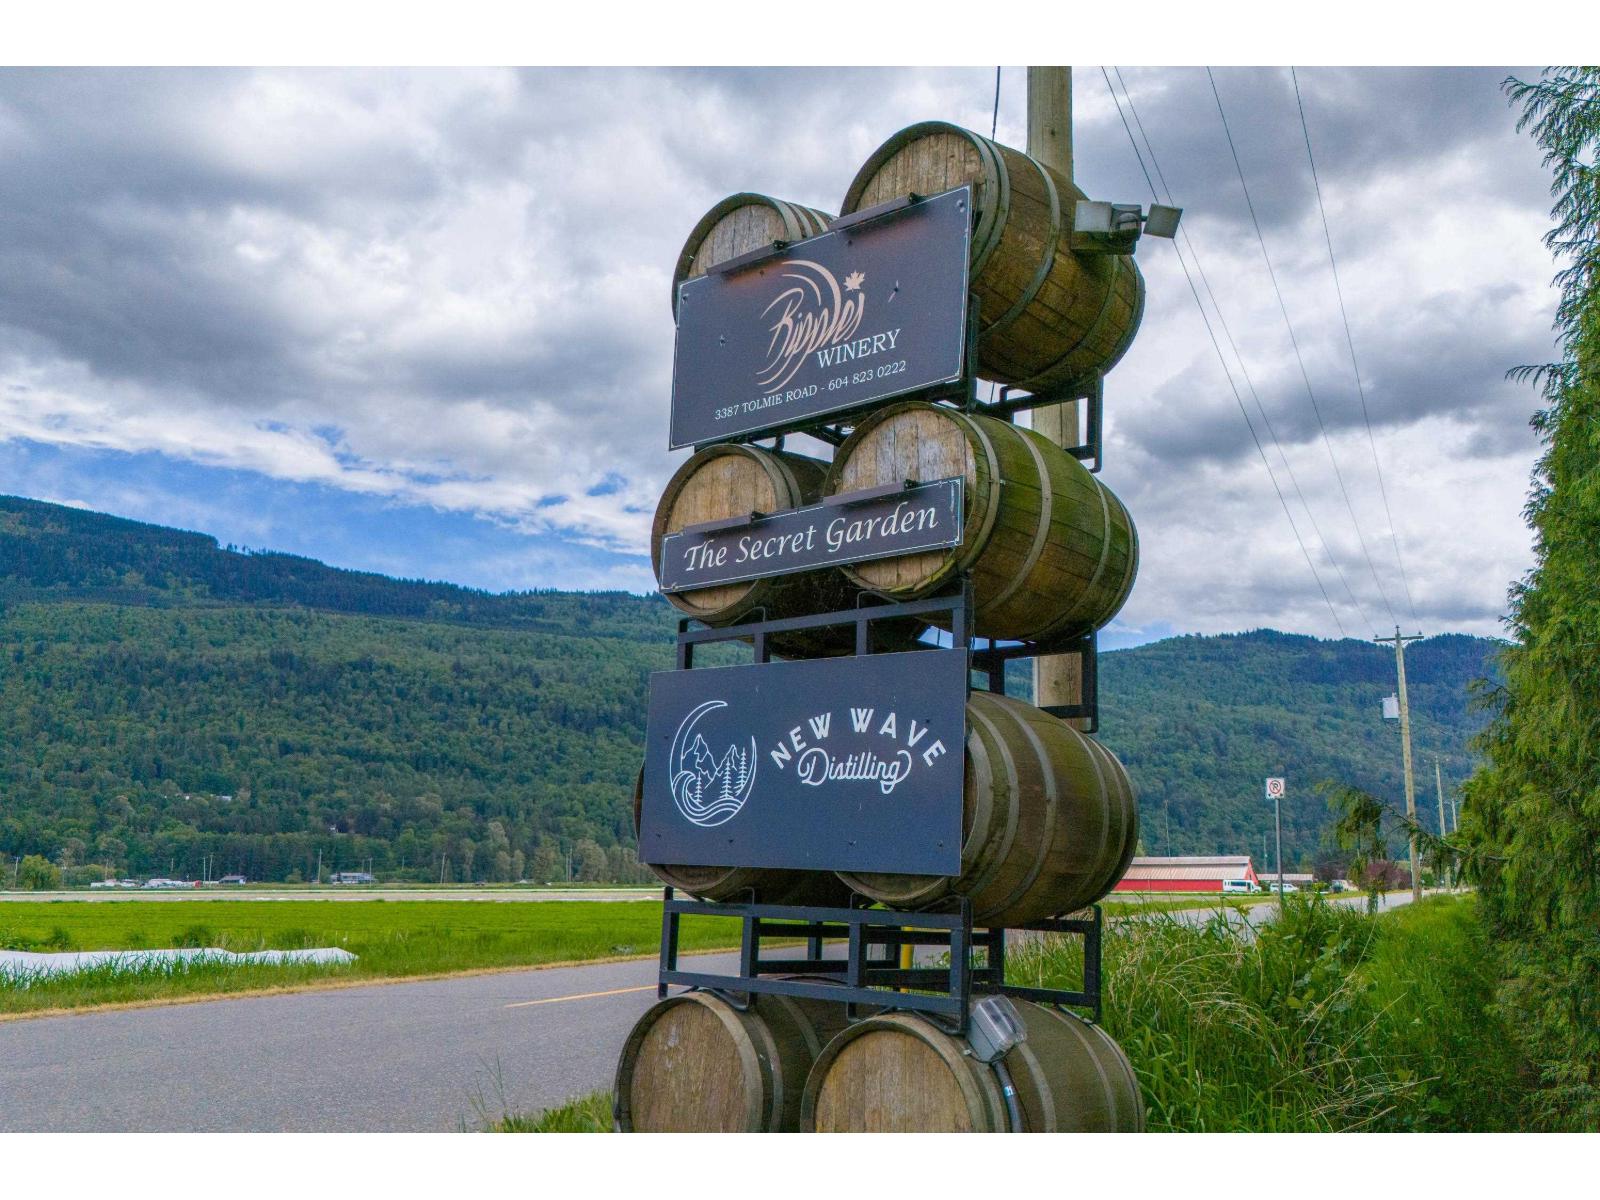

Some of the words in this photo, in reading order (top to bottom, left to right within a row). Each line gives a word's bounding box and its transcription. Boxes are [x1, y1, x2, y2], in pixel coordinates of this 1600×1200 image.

[816, 328, 901, 369] WINERY
[714, 408, 739, 420] 3387
[742, 394, 783, 413] TOLMIE
[785, 384, 818, 403] ROAD
[828, 378, 849, 393] 604
[852, 369, 874, 385] 823
[877, 359, 907, 378] 0222
[684, 541, 727, 571] The
[735, 525, 816, 563] Secret
[826, 501, 938, 553] Garden
[770, 712, 832, 770] NEW
[850, 707, 947, 767] WAVE
[798, 748, 911, 794] Distilling
